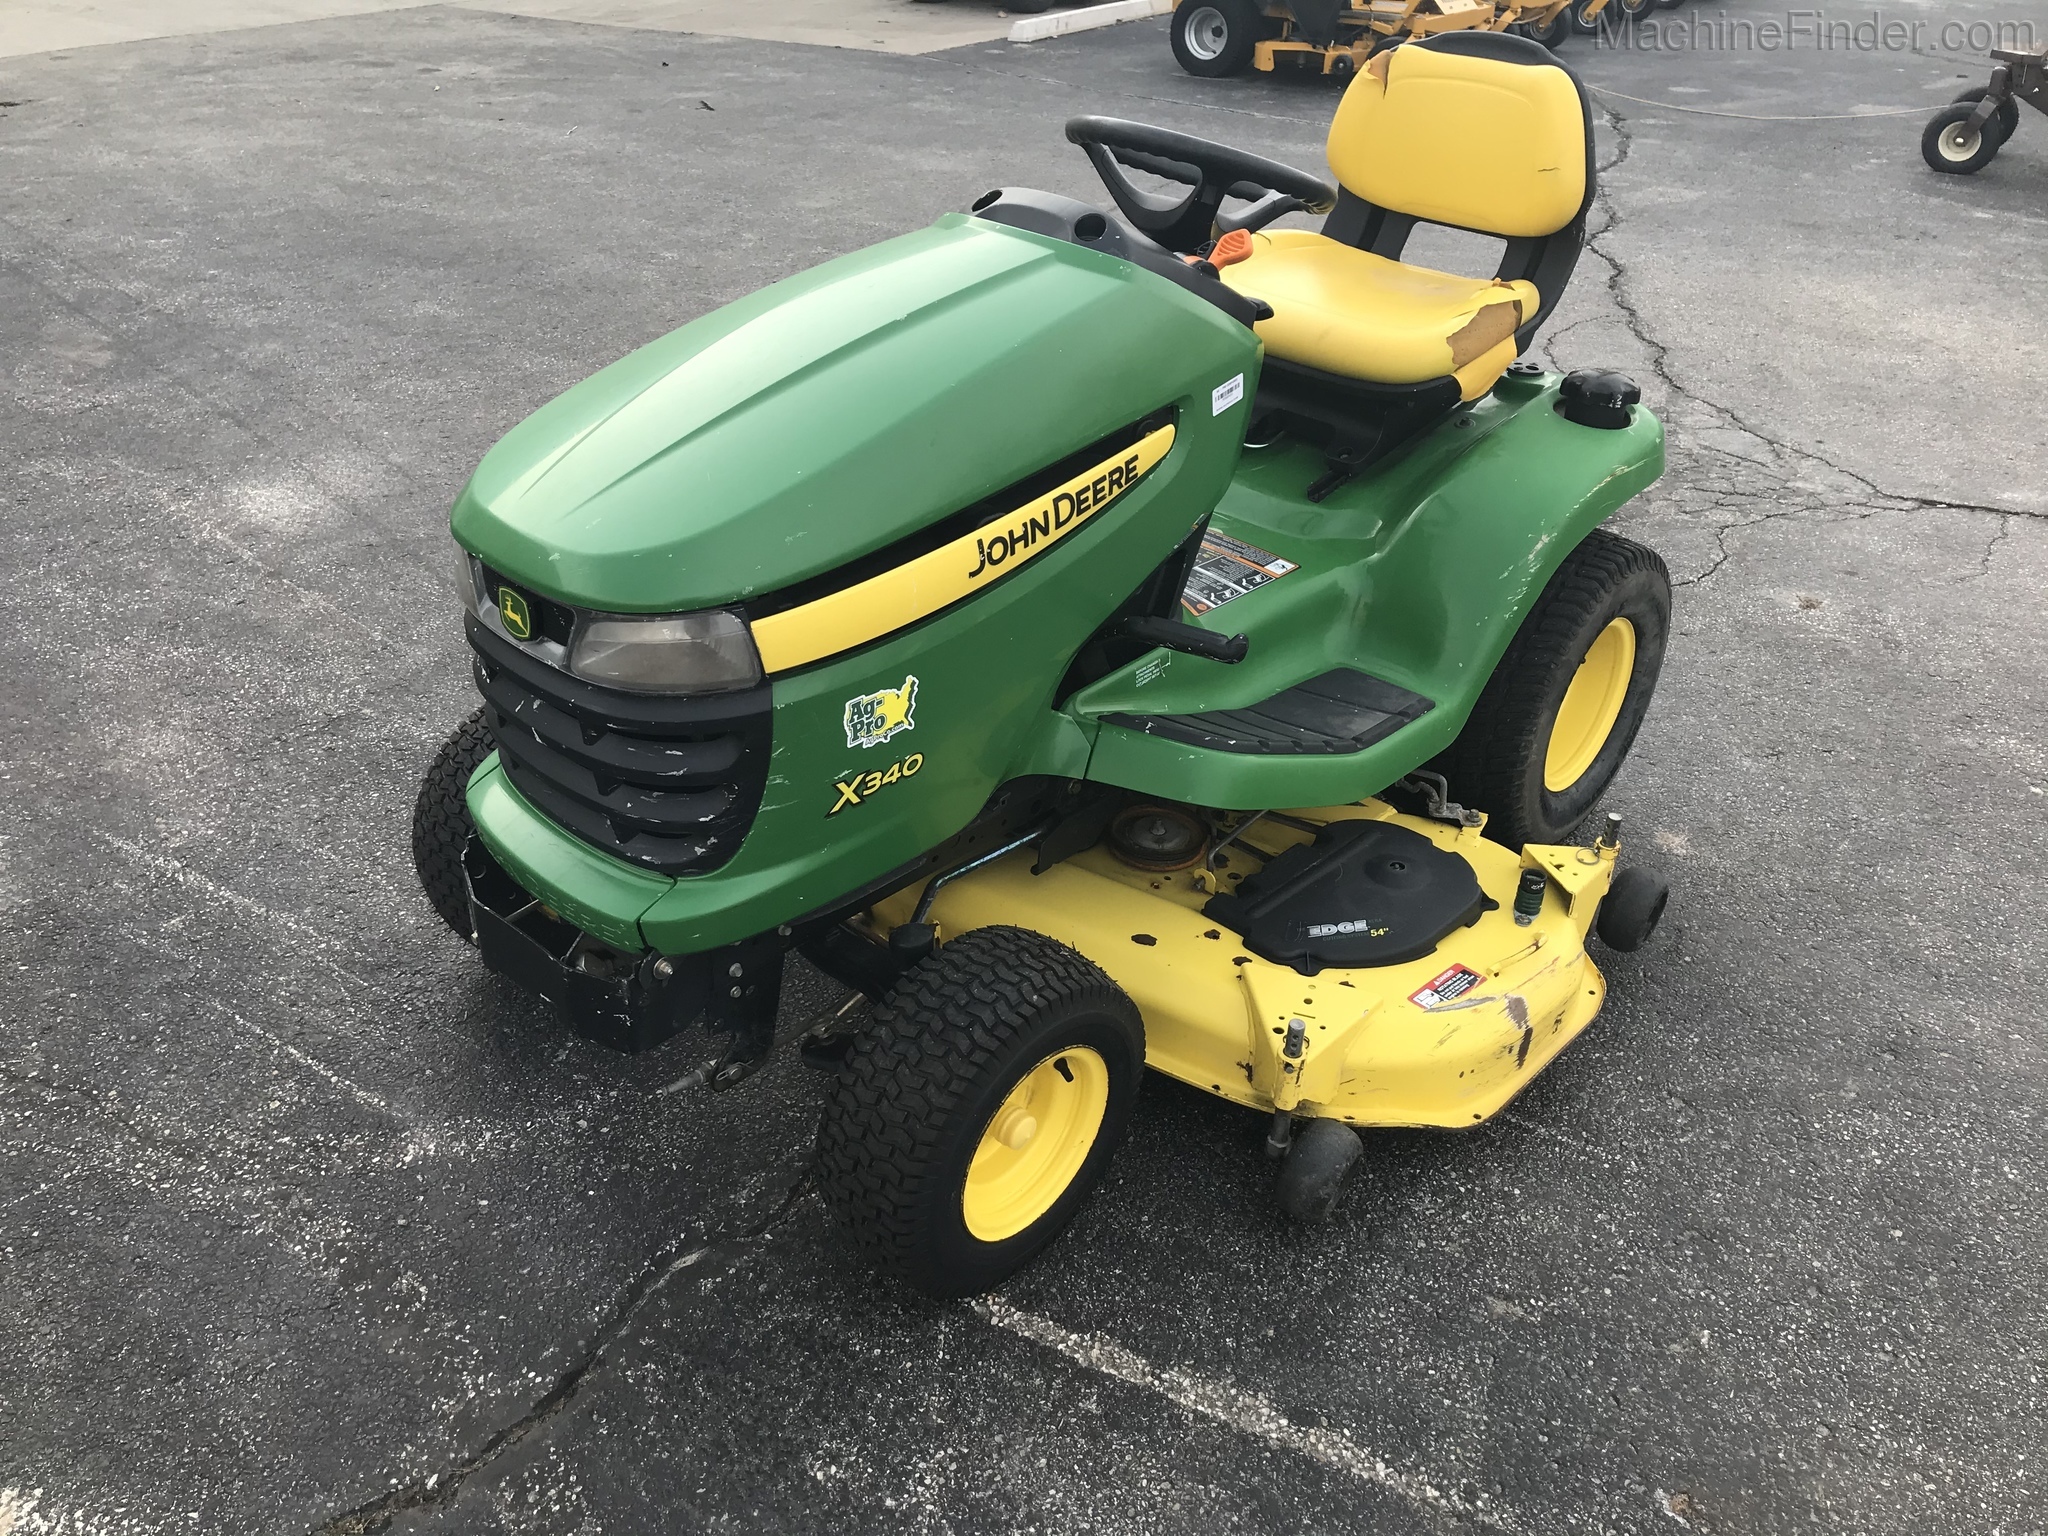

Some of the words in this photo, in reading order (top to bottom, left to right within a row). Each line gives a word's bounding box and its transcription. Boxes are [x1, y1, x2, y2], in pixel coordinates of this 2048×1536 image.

[968, 510, 1049, 579] JOHN
[1052, 454, 1139, 530] DEERE
[851, 714, 886, 742] Pro
[828, 752, 924, 816] X340
[1307, 919, 1369, 938] EDGE
[1370, 927, 1389, 937] 54"
